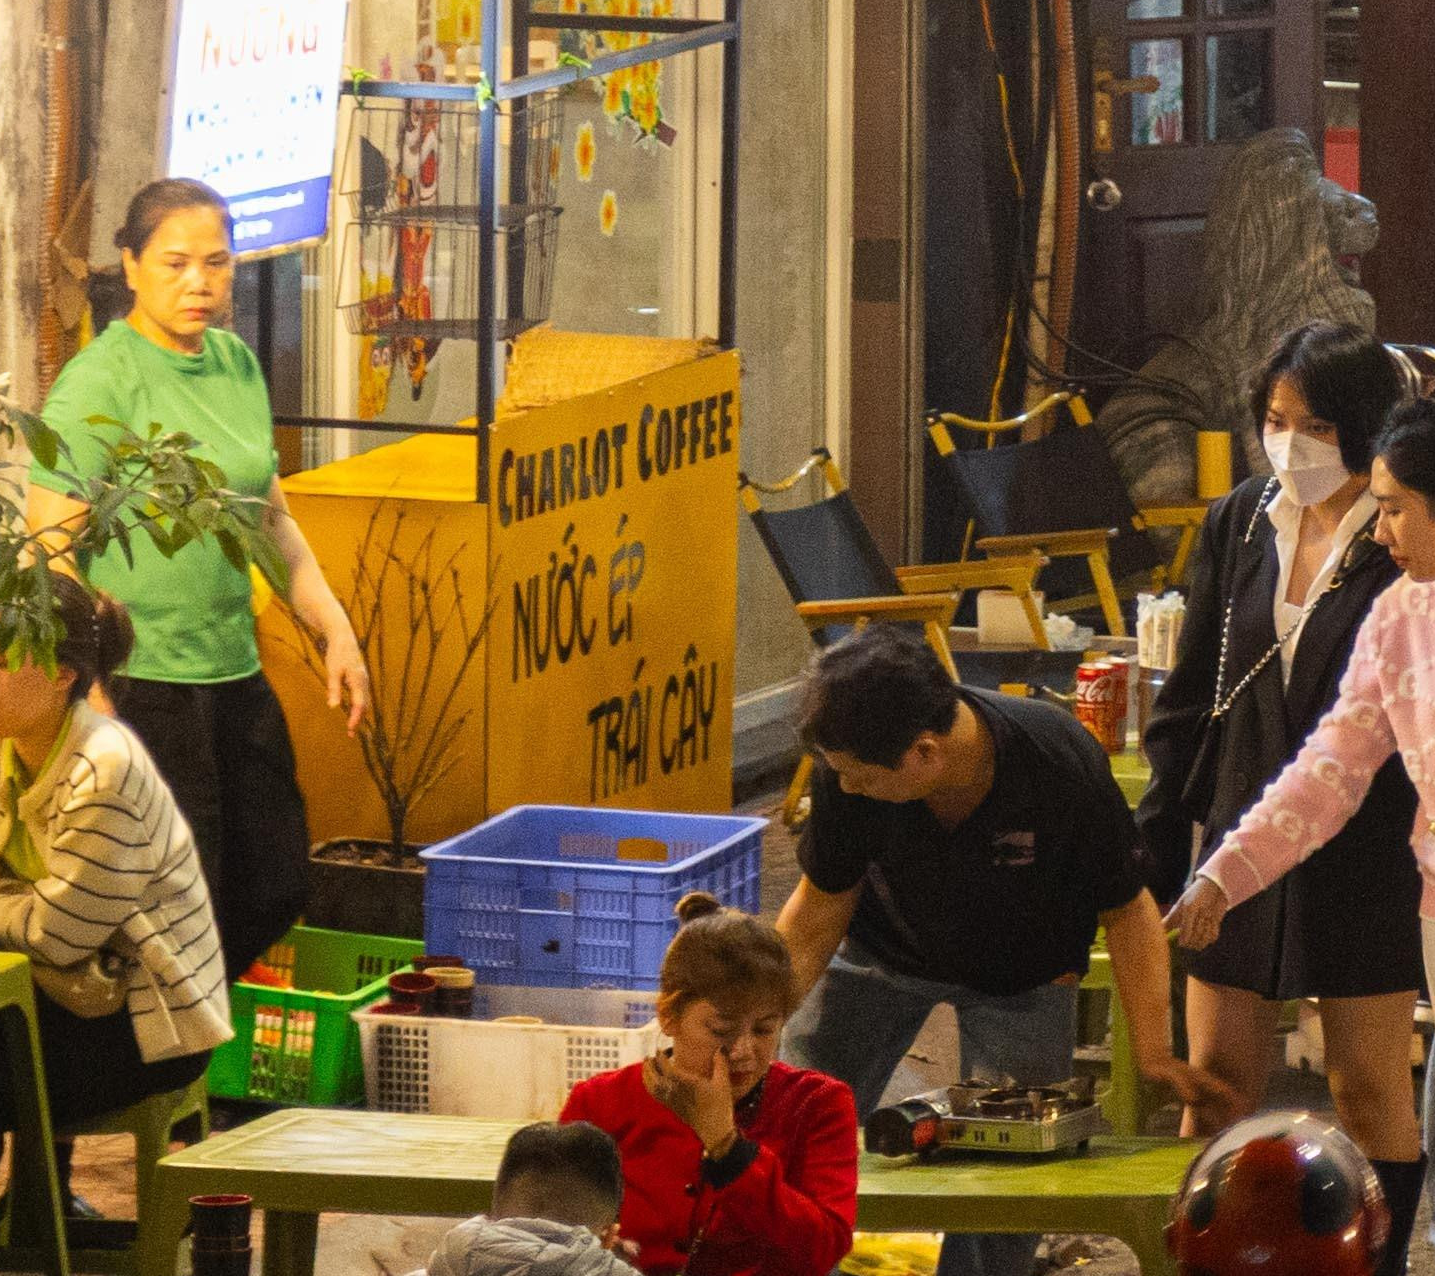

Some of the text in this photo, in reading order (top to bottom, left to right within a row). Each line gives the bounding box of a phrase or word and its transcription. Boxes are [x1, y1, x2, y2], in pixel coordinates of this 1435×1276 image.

[497, 390, 734, 528] CHARLOT COFFEE
[512, 513, 646, 684] NƯỚC ÉP
[586, 643, 717, 803] TRÁI CÂY
